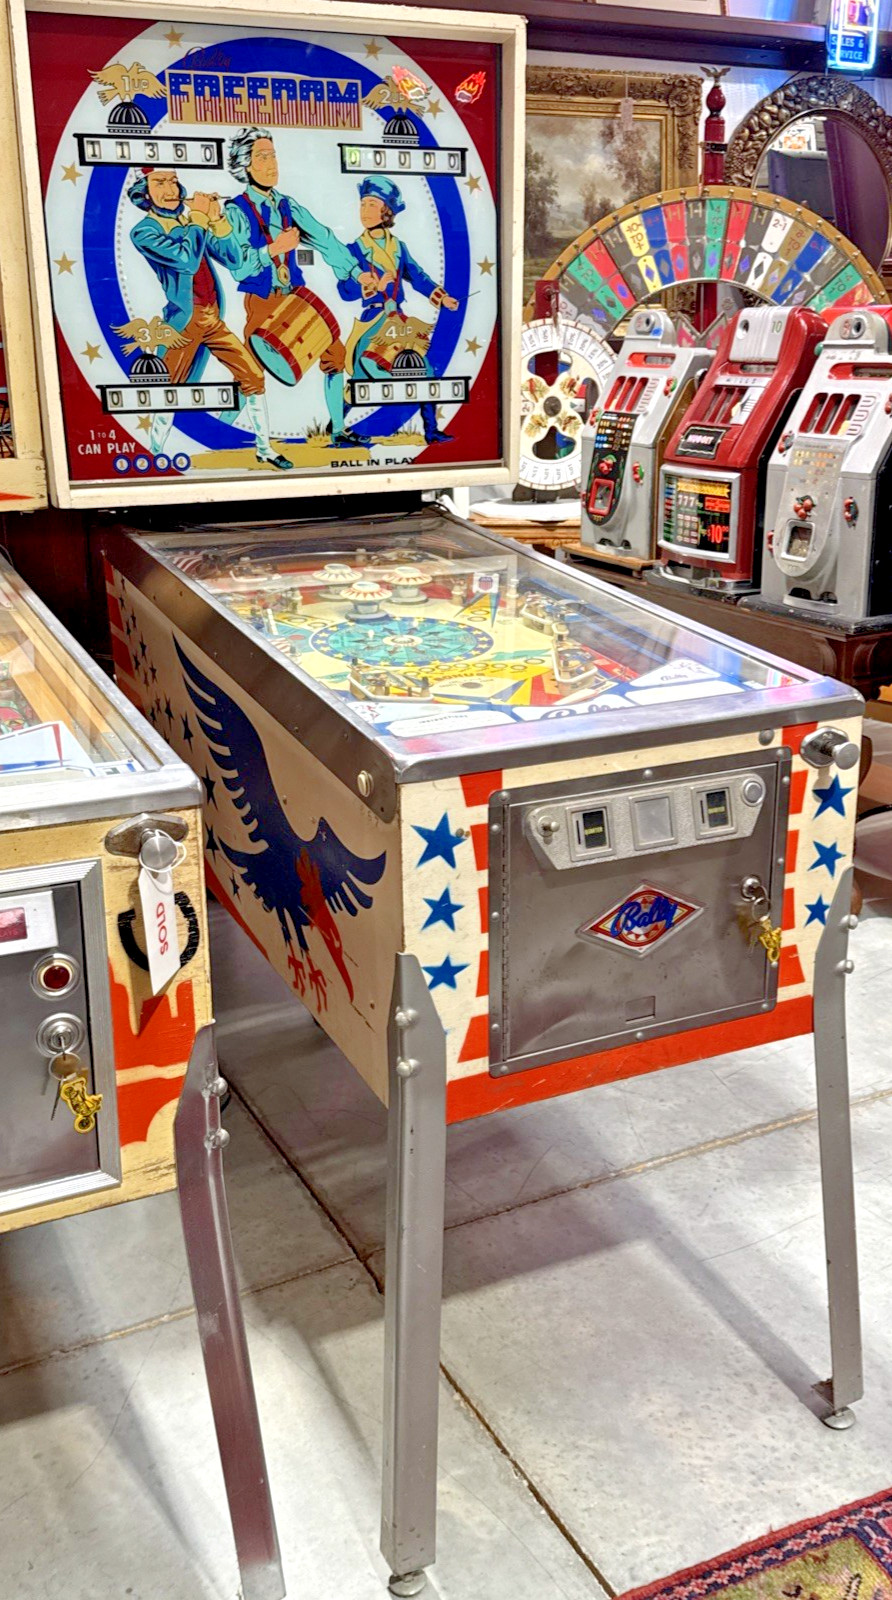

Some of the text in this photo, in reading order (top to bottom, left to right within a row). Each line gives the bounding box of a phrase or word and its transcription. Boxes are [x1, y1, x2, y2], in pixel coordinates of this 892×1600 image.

[831, 36, 855, 47] SLES
[831, 49, 863, 60] SRVICE
[169, 73, 360, 128] FREEDOM
[772, 218, 788, 231] 2-1
[108, 429, 116, 440] 4
[77, 441, 136, 455] CAN PLAY
[331, 456, 417, 468] BALL IN PLAY
[434, 672, 486, 682] BONUS
[610, 895, 678, 937] Bally
[156, 902, 169, 955] SOLD
